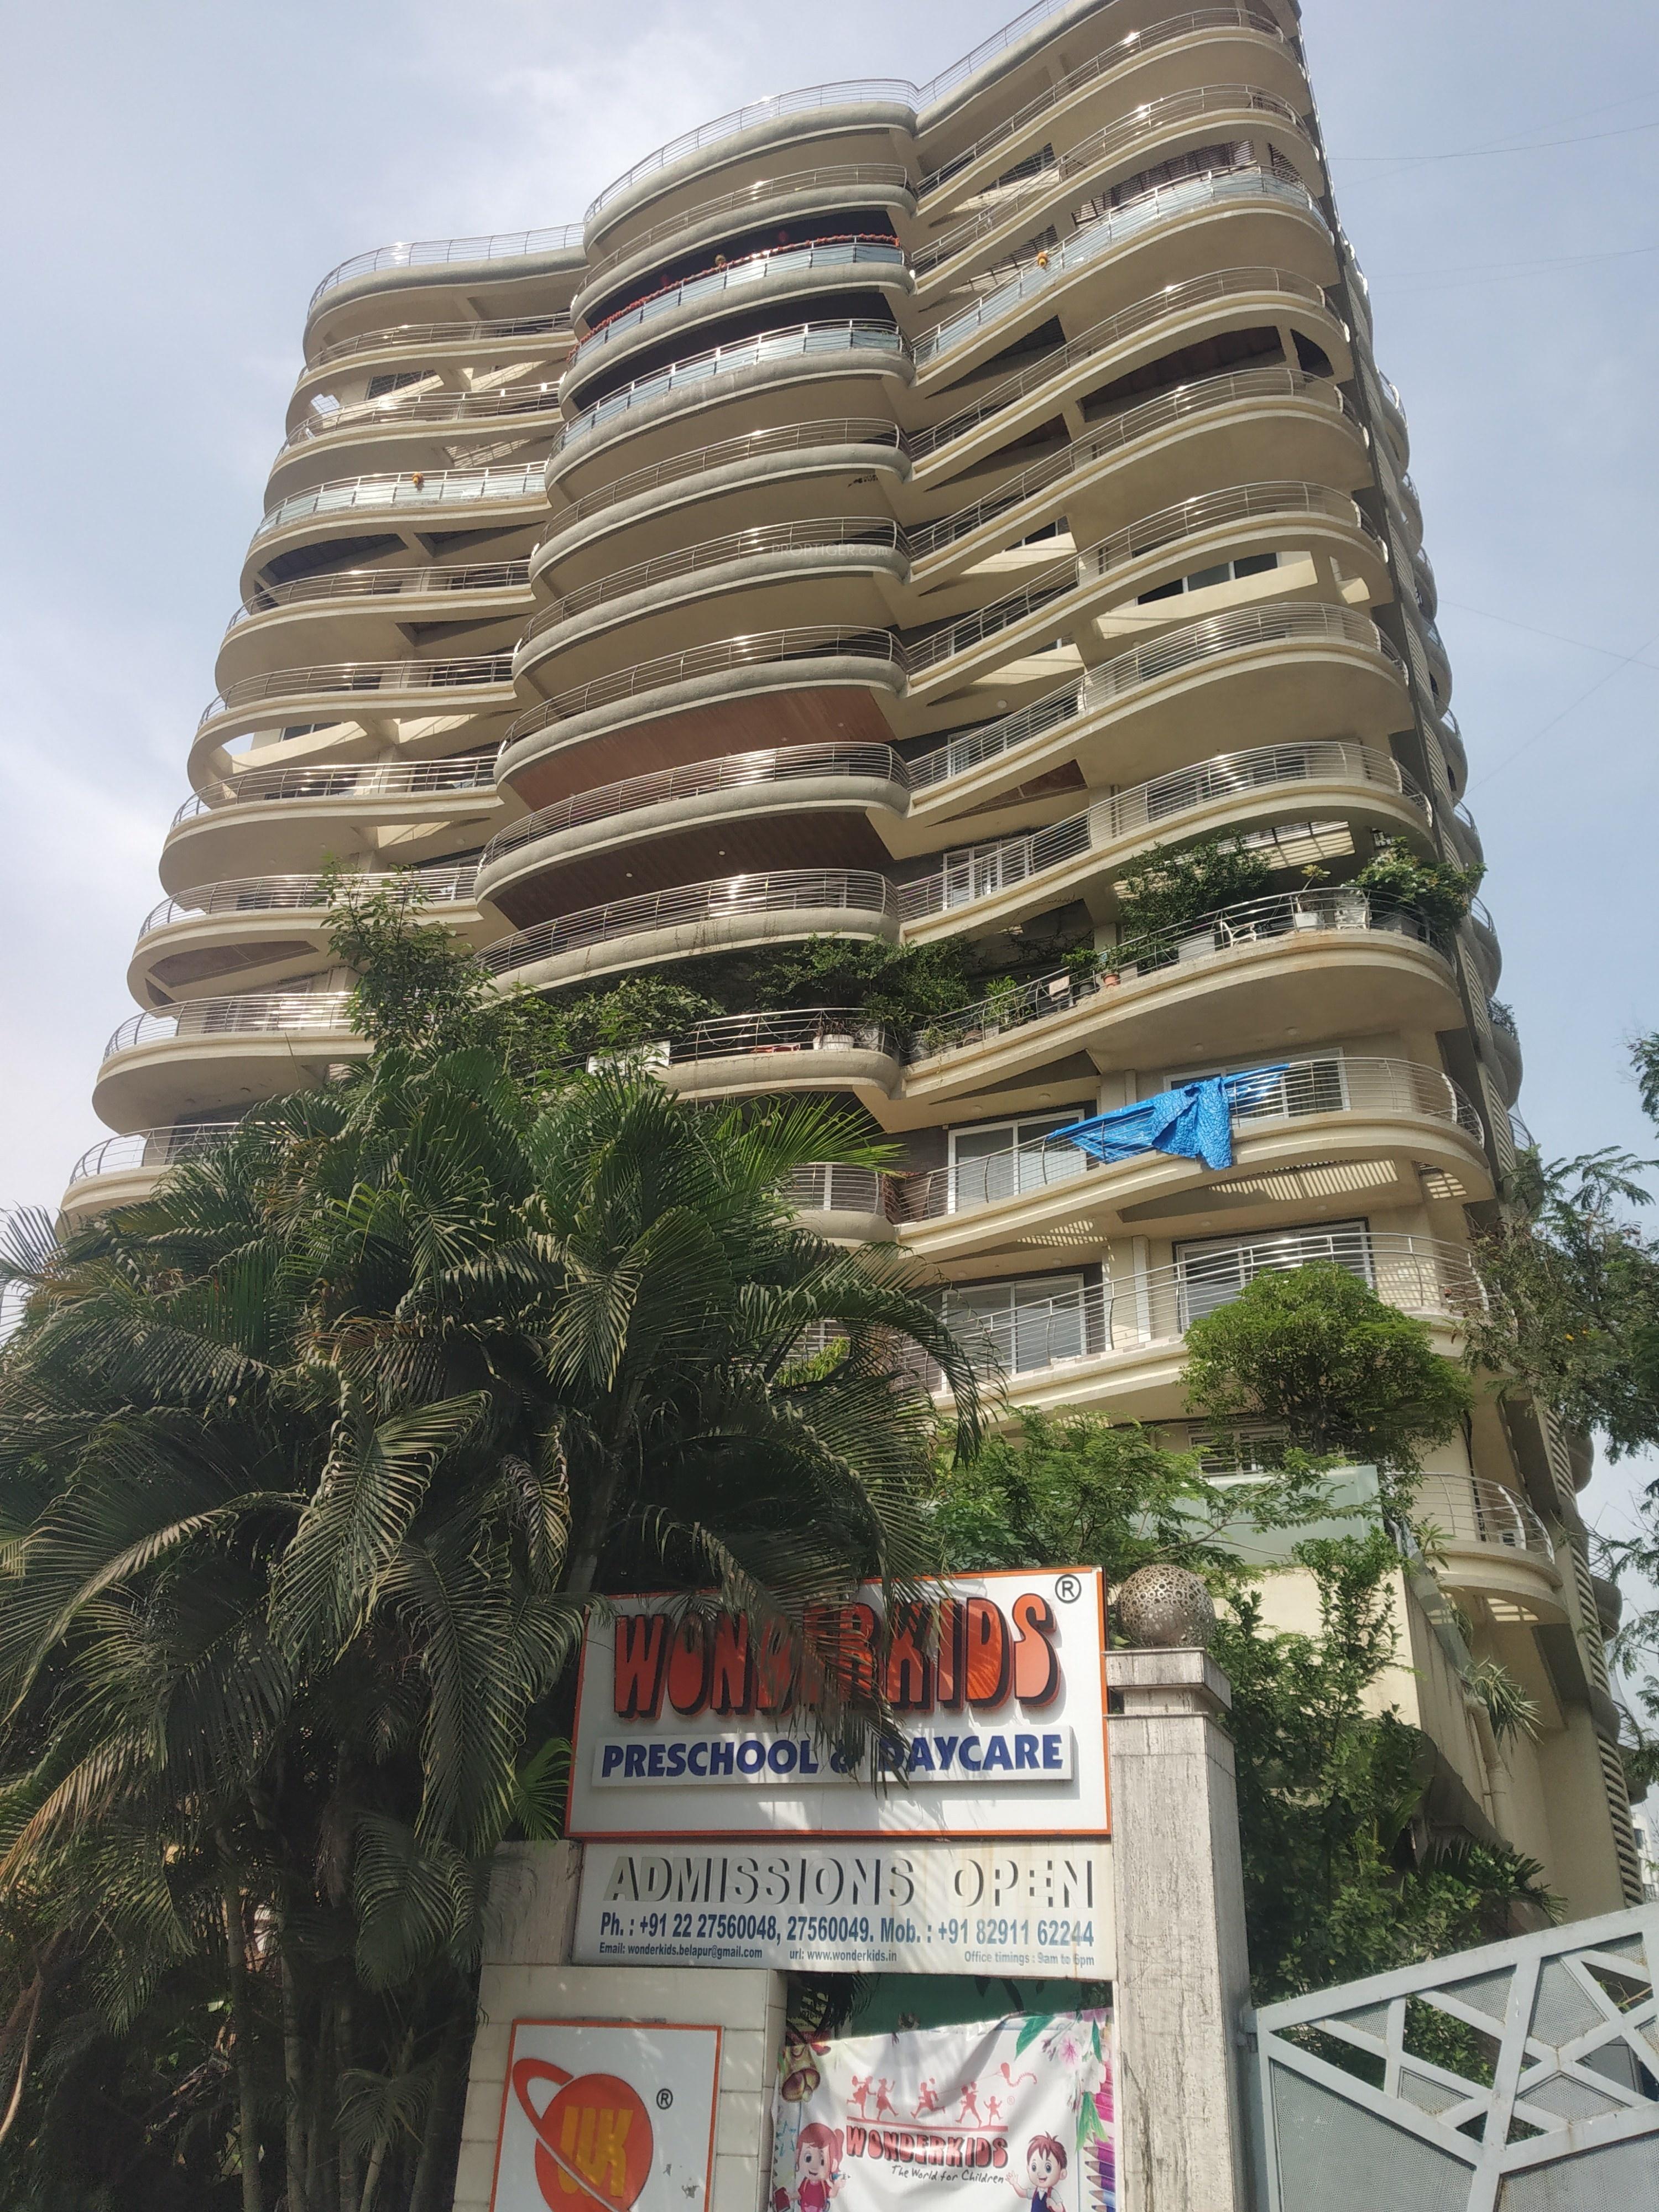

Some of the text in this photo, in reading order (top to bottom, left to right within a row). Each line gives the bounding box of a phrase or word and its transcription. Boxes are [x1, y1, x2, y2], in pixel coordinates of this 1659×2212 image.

[602, 1739, 819, 1778] PRESCHOOL
[878, 1734, 1063, 1772] DAYCARE
[603, 1856, 1093, 1908] ADMISSIONS OPEN
[640, 1913, 667, 1937] +91
[672, 1913, 692, 1937] 22
[697, 1914, 781, 1945] 27560048,
[786, 1916, 874, 1943] 27560049.
[880, 1917, 921, 1944] Mob.
[938, 1918, 968, 1944] +91
[976, 1919, 1029, 1945] 82911
[1037, 1920, 1094, 1947] 62244
[599, 1942, 625, 1955] Email:
[628, 1943, 763, 1959] wonderkids.belapur@gmail.com
[790, 1948, 804, 1960] url:
[807, 1949, 897, 1962] www.wonderkids.in
[964, 1950, 992, 1963] Office
[995, 1952, 1030, 1966] timings
[1037, 1952, 1058, 1964] 9am
[1061, 1954, 1071, 1965] to
[846, 2125, 1009, 2168] WONDERKIDS
[891, 2165, 1004, 2183] The World for Children
